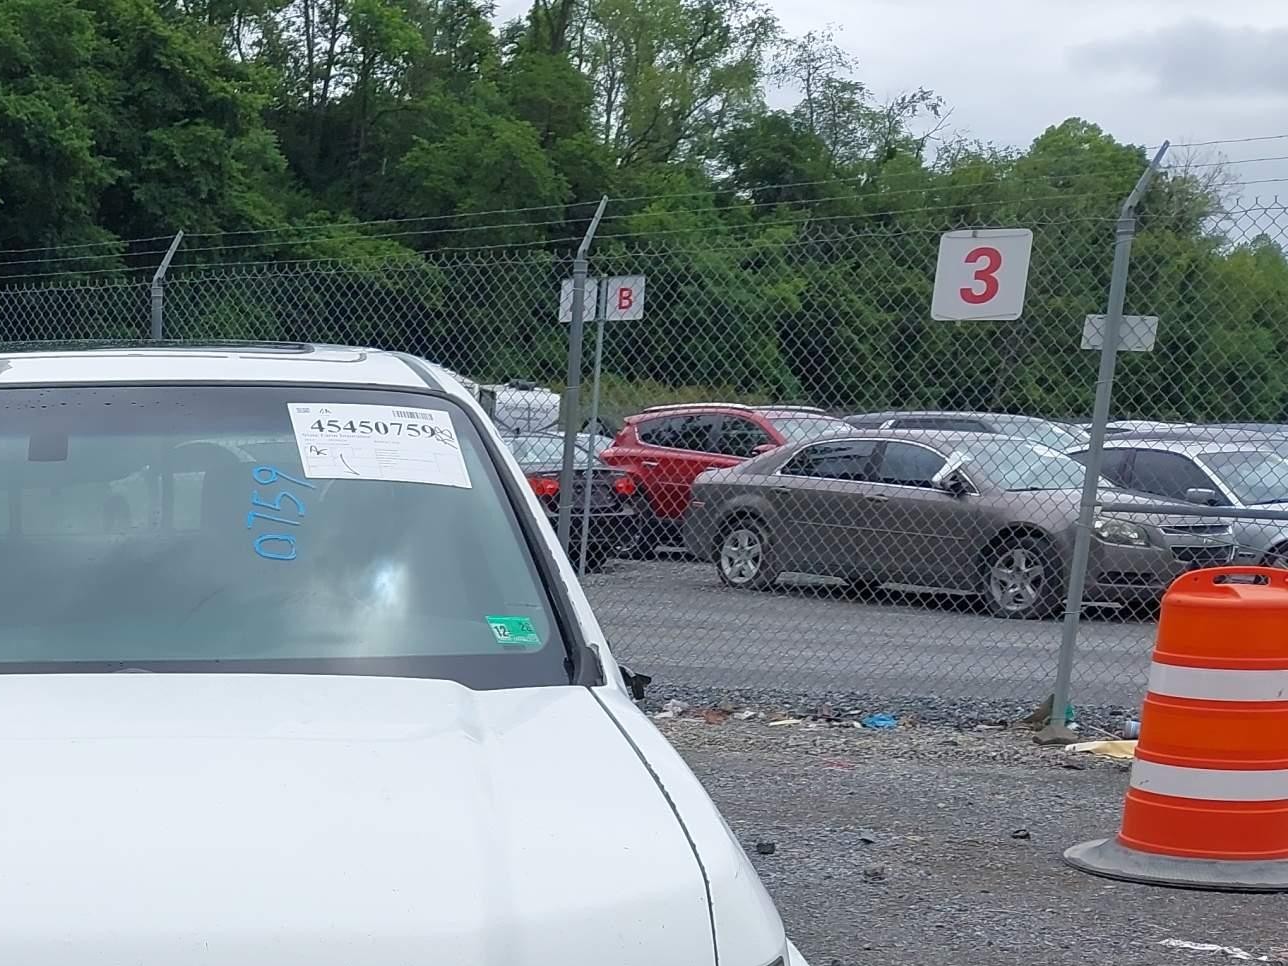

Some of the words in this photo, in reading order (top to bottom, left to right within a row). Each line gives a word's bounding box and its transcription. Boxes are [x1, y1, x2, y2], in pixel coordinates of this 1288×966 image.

[959, 246, 1002, 305] 3
[618, 287, 633, 310] B
[310, 419, 436, 438] 45450759
[247, 465, 318, 561] 0759
[493, 625, 509, 637] 12
